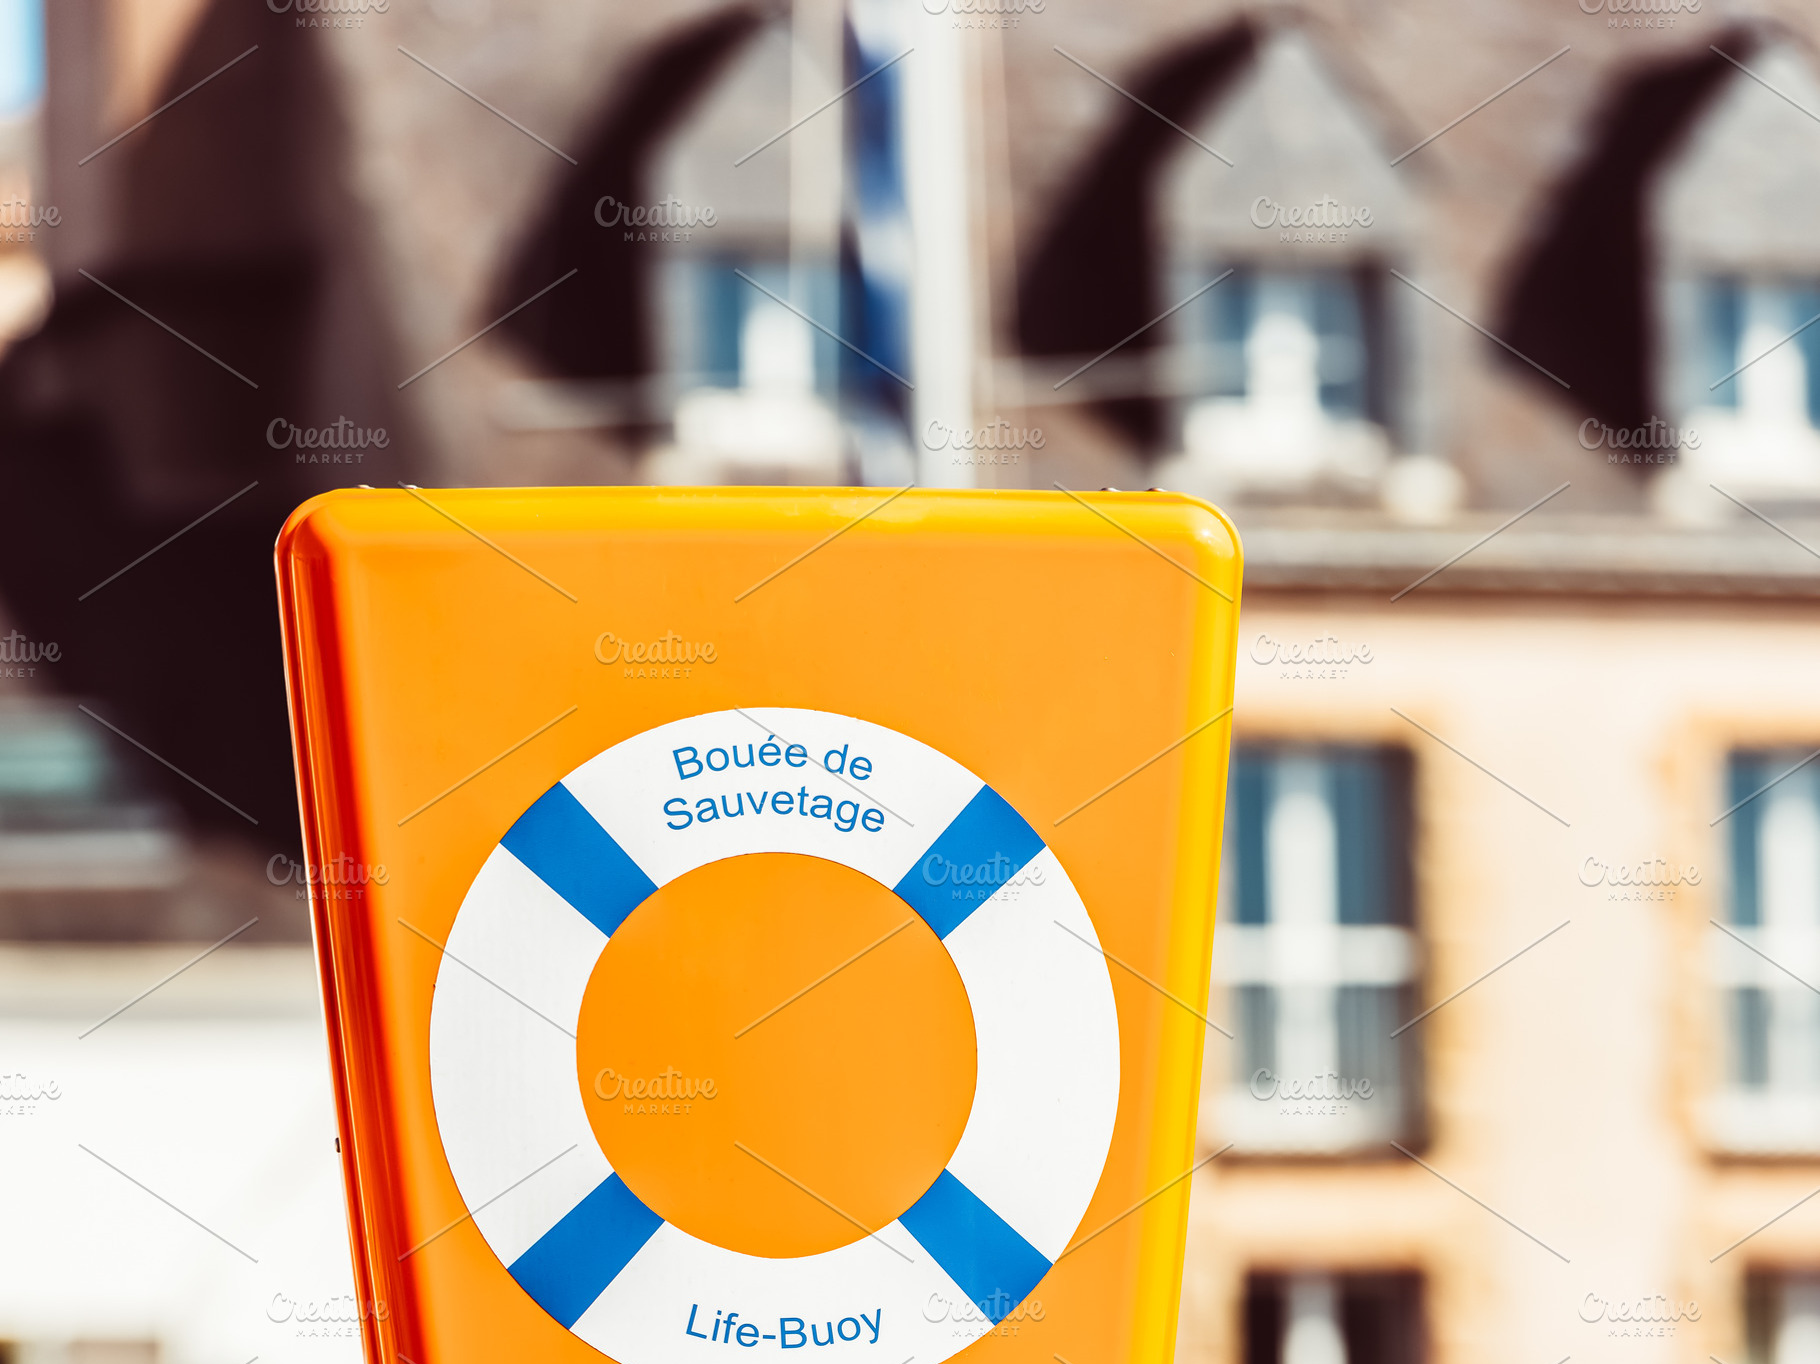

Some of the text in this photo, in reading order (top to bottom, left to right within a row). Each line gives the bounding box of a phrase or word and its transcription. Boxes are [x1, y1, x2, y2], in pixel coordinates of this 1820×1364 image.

[673, 734, 873, 781] Bouée de
[663, 786, 885, 832] Sauvetage
[685, 1303, 881, 1349] Life-Buoy
